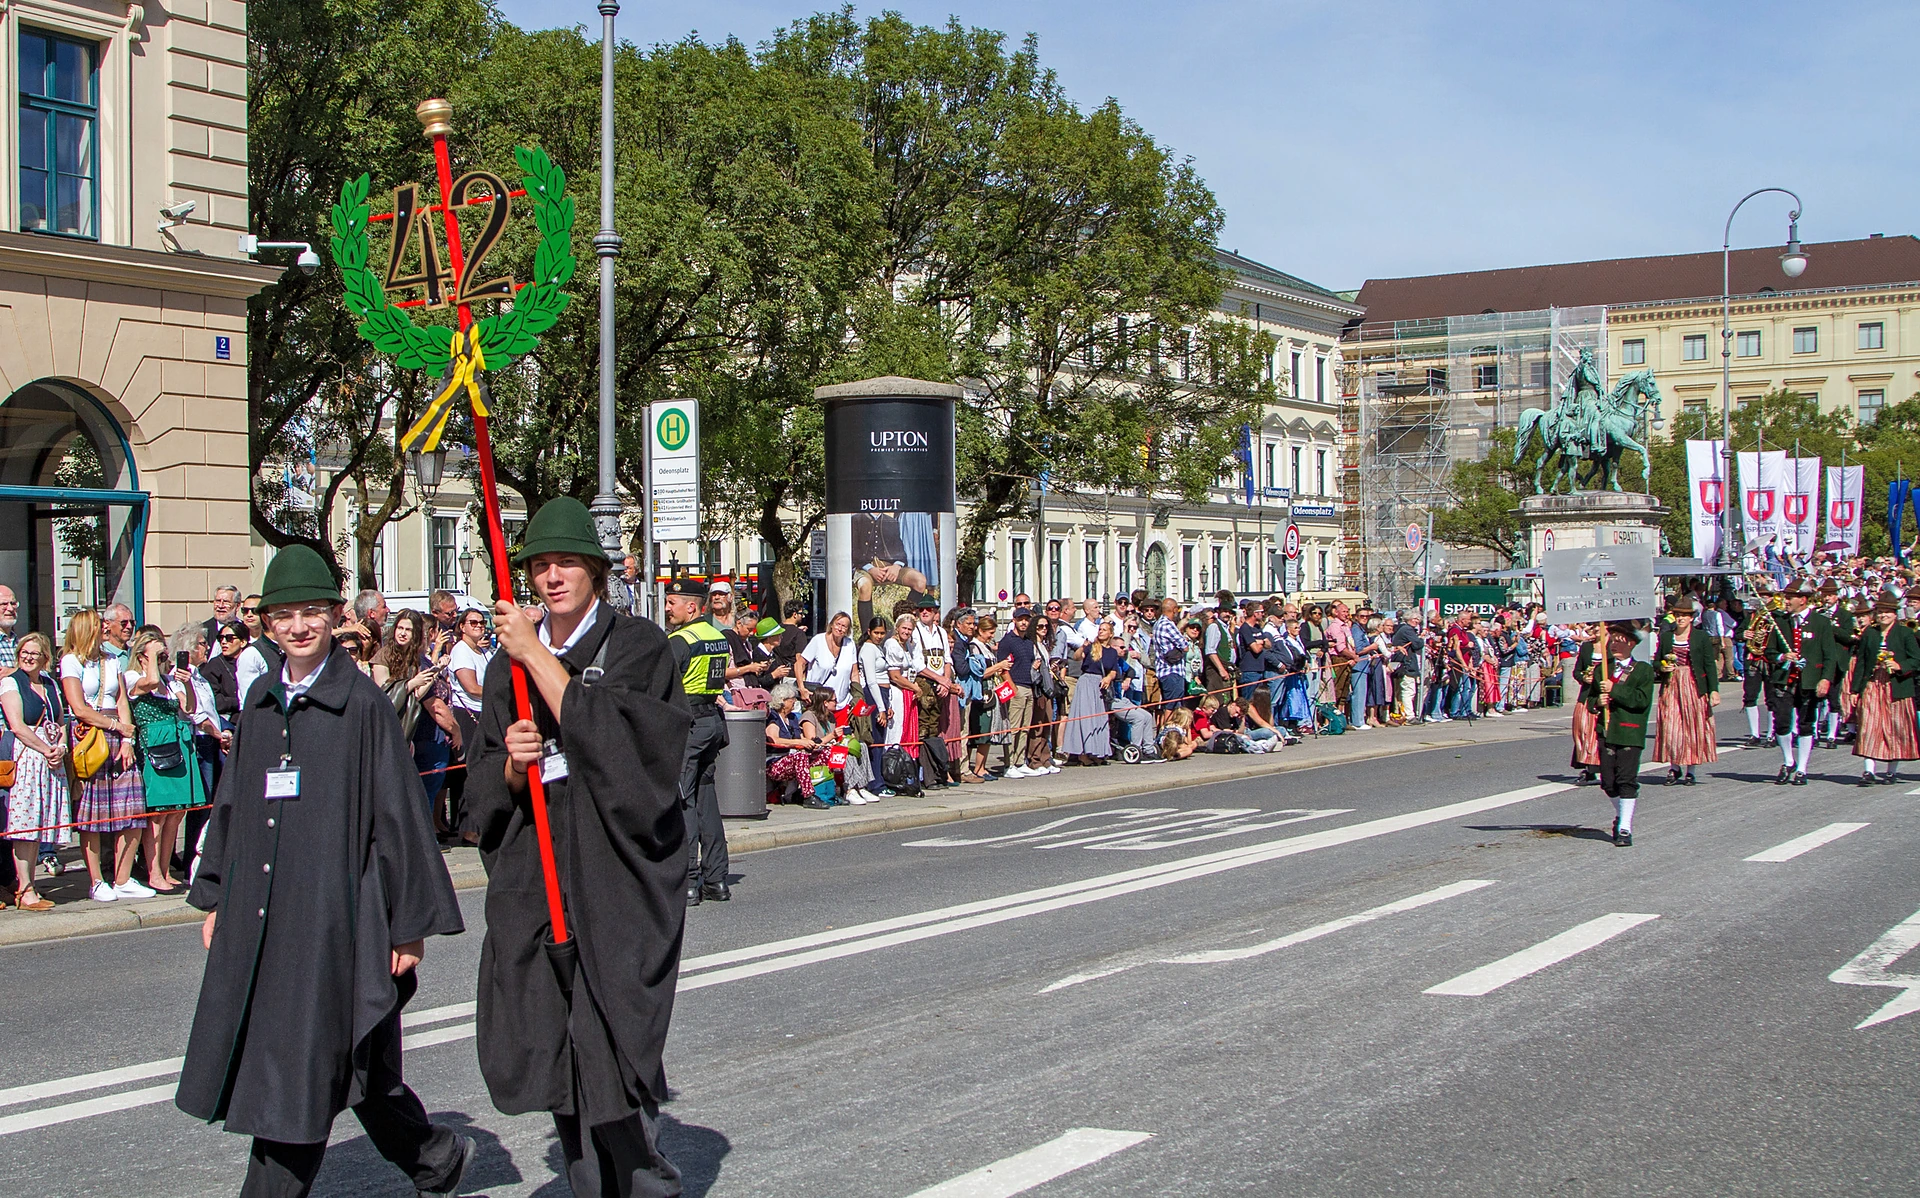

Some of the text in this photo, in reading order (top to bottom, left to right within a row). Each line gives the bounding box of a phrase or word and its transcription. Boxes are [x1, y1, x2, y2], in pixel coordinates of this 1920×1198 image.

[385, 171, 516, 310] 42
[220, 338, 226, 349] 2
[666, 417, 680, 441] H
[871, 431, 928, 446] UPTON
[1265, 488, 1289, 497] Odeonsplatz
[861, 499, 900, 510] BUILT
[1293, 507, 1333, 517] Odeonsplatz
[1618, 531, 1643, 545] SPATEN
[705, 642, 728, 652] POLIZEI
[716, 659, 723, 668] BY
